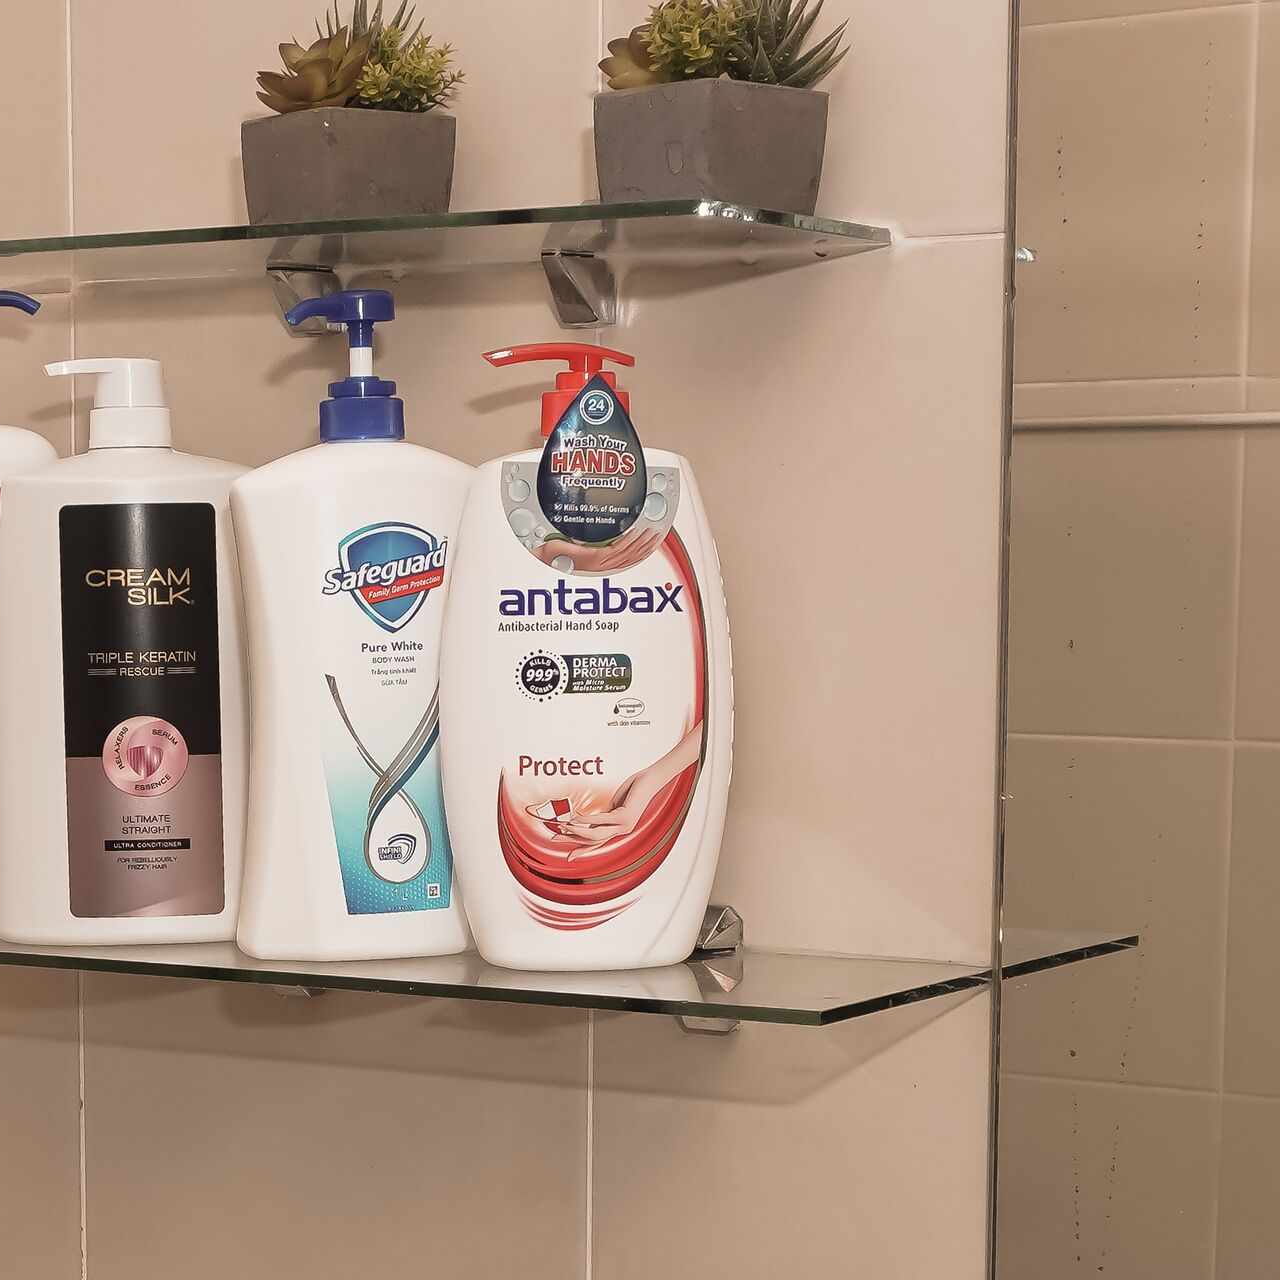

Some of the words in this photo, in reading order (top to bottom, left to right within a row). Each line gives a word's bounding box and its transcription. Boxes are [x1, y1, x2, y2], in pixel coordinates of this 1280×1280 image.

[588, 398, 605, 411] 24
[563, 434, 595, 449] Wash
[600, 435, 627, 450] Your
[551, 449, 636, 475] HANDS
[561, 475, 626, 490] Frequently
[564, 504, 578, 512] Kills
[321, 540, 448, 595] Safeguard
[85, 568, 191, 587] CREAM
[368, 588, 391, 599] Family
[391, 583, 409, 594] Germ
[409, 575, 441, 588] Protection
[127, 587, 191, 606] SILK
[499, 579, 684, 616] antabax
[498, 620, 563, 632] Antibacterial
[566, 621, 592, 631] Hand
[595, 620, 620, 632] Soap
[361, 643, 388, 653] Pure
[391, 641, 423, 652] White
[87, 652, 134, 664] TRIPLE
[139, 650, 197, 663] KERATIN
[529, 658, 552, 667] KILLS
[573, 657, 617, 668] DERMA
[119, 666, 165, 676] RESCUE
[573, 667, 626, 678] PROTECT
[530, 683, 553, 693] GERMS
[152, 728, 178, 746] SERUM
[114, 726, 129, 770] RELAXERS
[520, 756, 604, 776] Protect
[134, 773, 172, 791] ESSENCE
[122, 814, 171, 824] ULTIMATE
[121, 825, 172, 835] STRAIGHT
[136, 840, 182, 848] CONDITIONER
